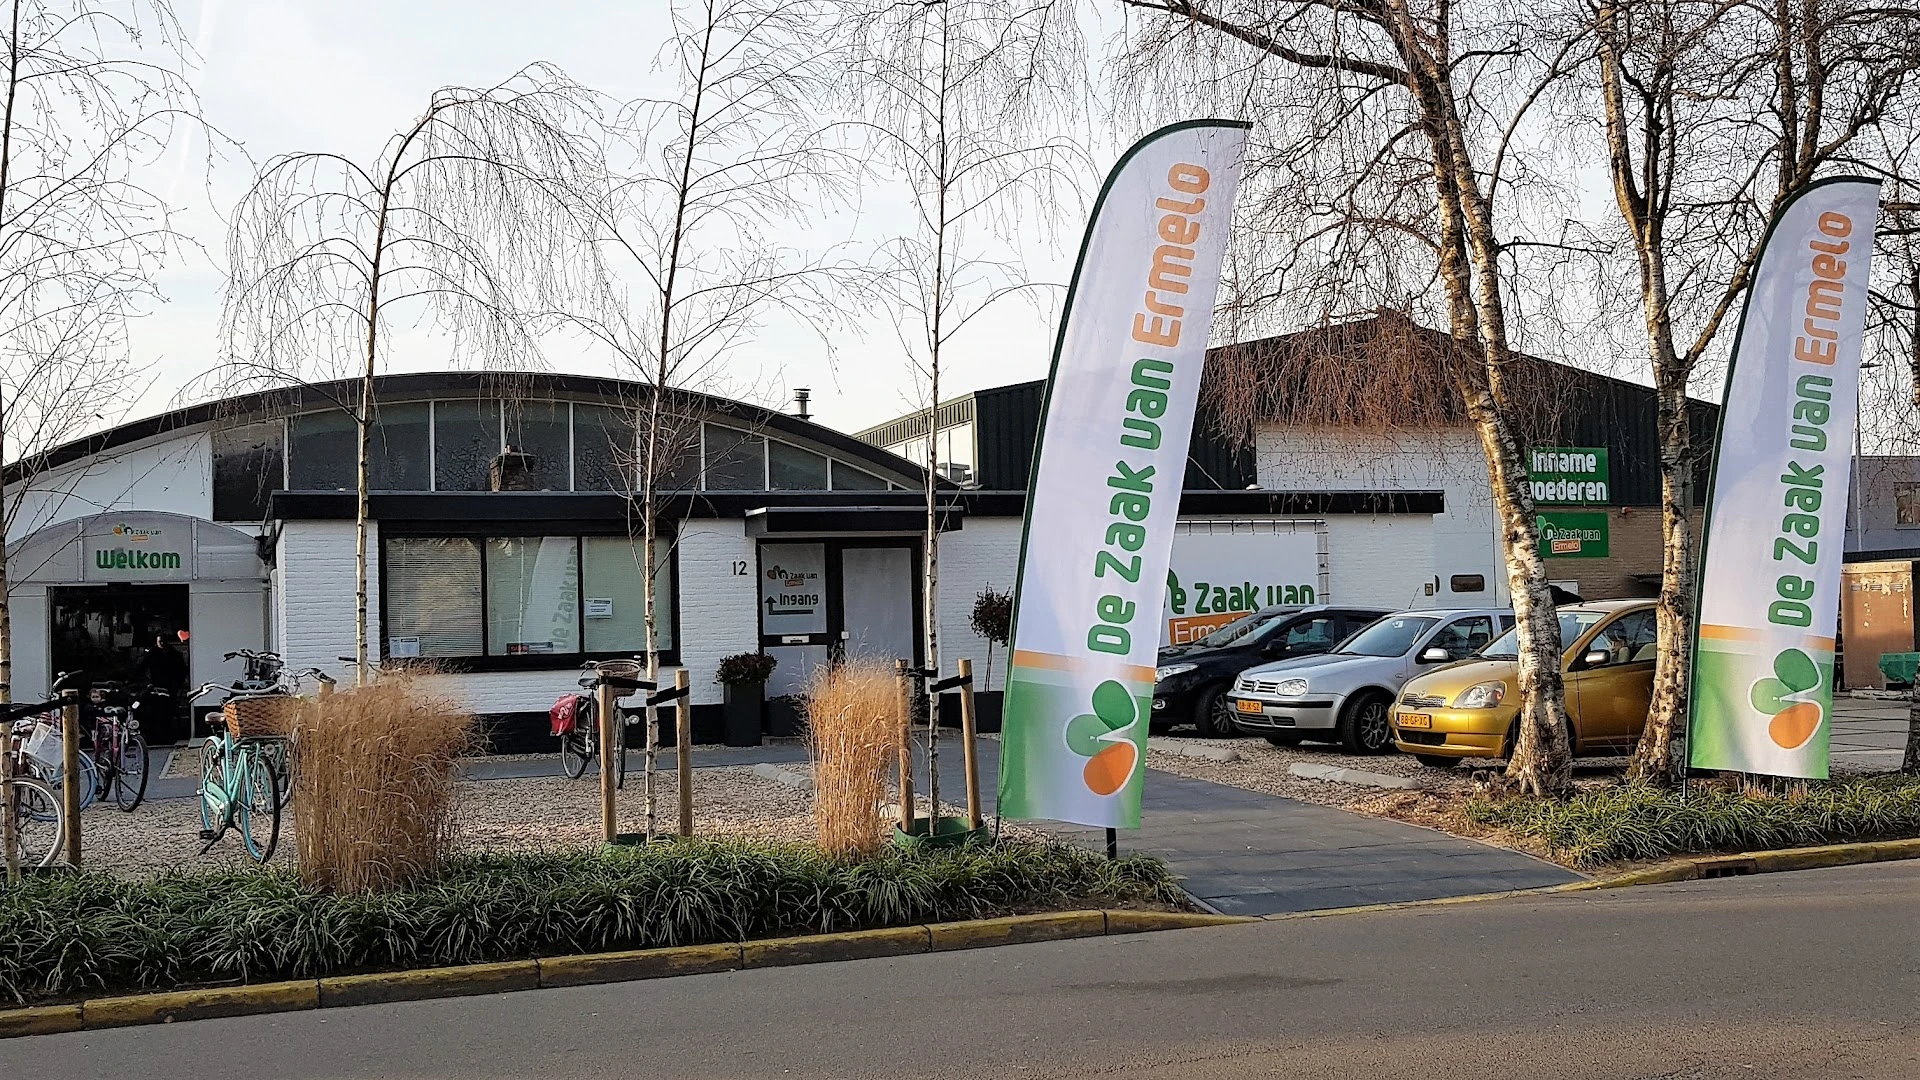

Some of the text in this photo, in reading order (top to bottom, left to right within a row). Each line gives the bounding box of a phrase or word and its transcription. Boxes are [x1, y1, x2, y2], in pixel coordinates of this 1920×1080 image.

[1133, 163, 1211, 348] Ermelo
[1795, 210, 1853, 366] Ermelo
[1532, 450, 1597, 472] Inname
[1095, 460, 1156, 583] Zaak
[1774, 461, 1825, 565] Zaak
[1553, 541, 1579, 551] Ermelo
[1559, 528, 1582, 540] Zaak
[96, 550, 181, 569] Welkom
[732, 560, 748, 576] 12
[780, 593, 819, 606] Ingang
[1194, 581, 1260, 614] Zaak
[1769, 575, 1815, 628] De
[1088, 596, 1136, 656] De
